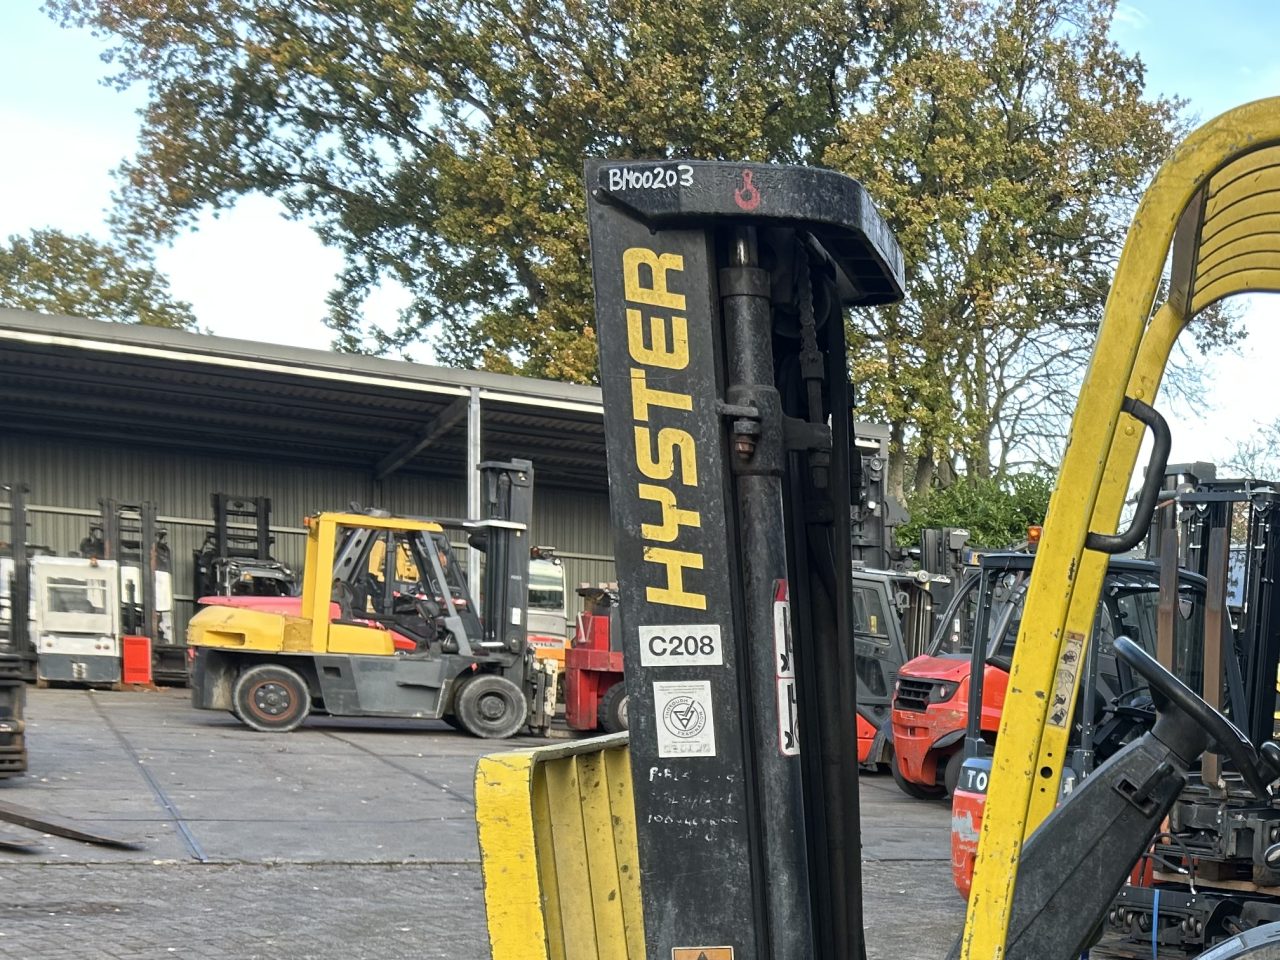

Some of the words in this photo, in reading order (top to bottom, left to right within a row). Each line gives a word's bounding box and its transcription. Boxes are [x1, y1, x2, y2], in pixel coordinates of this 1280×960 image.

[609, 164, 694, 191] BM00203
[622, 247, 707, 611] HYSTER
[648, 635, 715, 656] C208
[665, 698, 689, 719] THOROUGH
[677, 711, 704, 736] EXAMINATION
